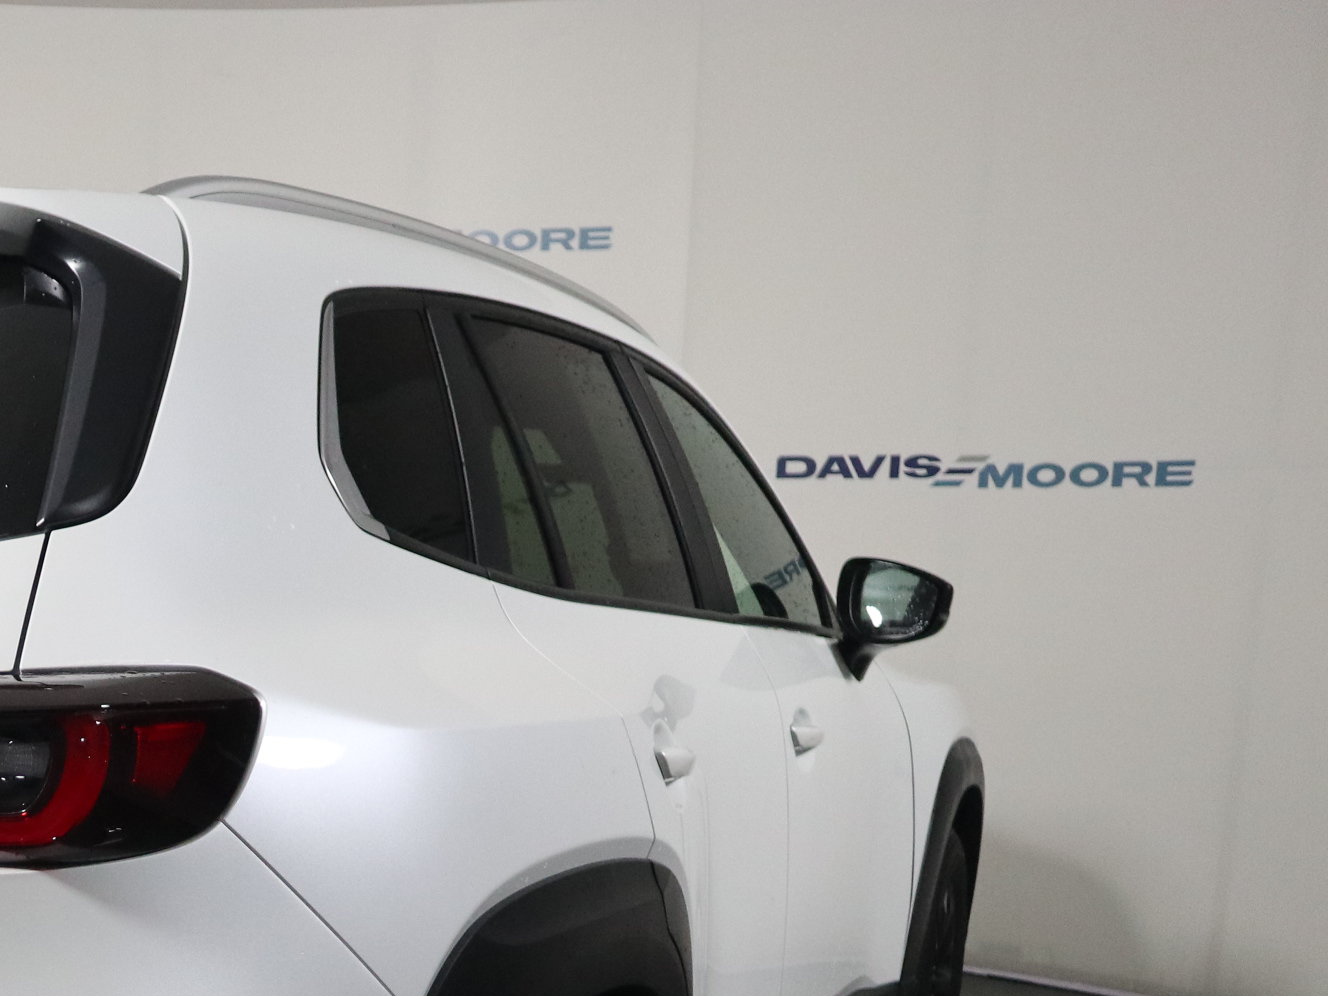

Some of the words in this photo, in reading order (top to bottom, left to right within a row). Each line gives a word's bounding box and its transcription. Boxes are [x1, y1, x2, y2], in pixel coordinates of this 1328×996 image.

[453, 226, 613, 251] OORE
[775, 455, 940, 480] DAVIS
[977, 459, 1197, 489] MOORE
